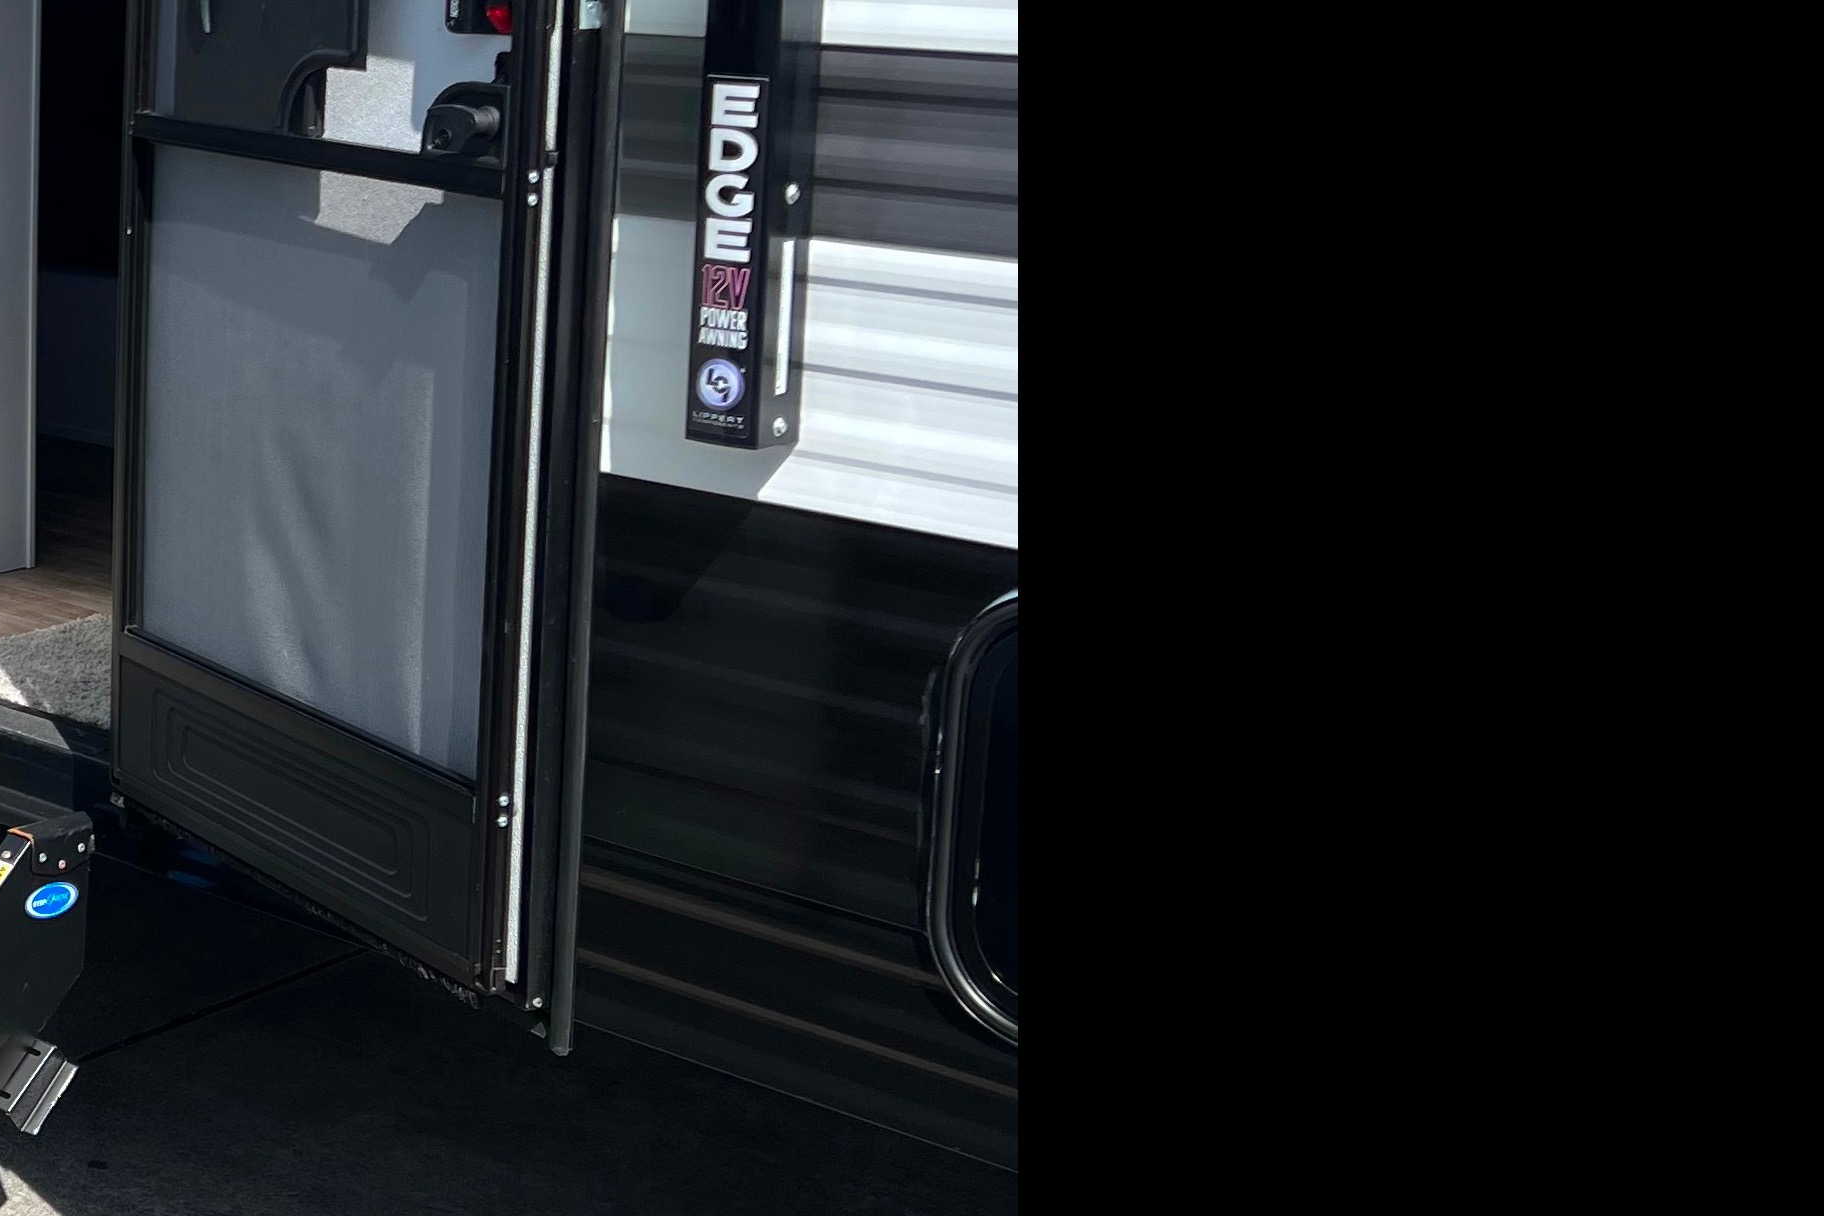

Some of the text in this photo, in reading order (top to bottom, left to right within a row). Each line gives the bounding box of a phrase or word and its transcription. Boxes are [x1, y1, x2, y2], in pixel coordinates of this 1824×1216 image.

[703, 84, 760, 263] EDGE
[701, 264, 752, 311] 12V
[700, 307, 748, 331] POWER
[698, 327, 748, 350] AWNING
